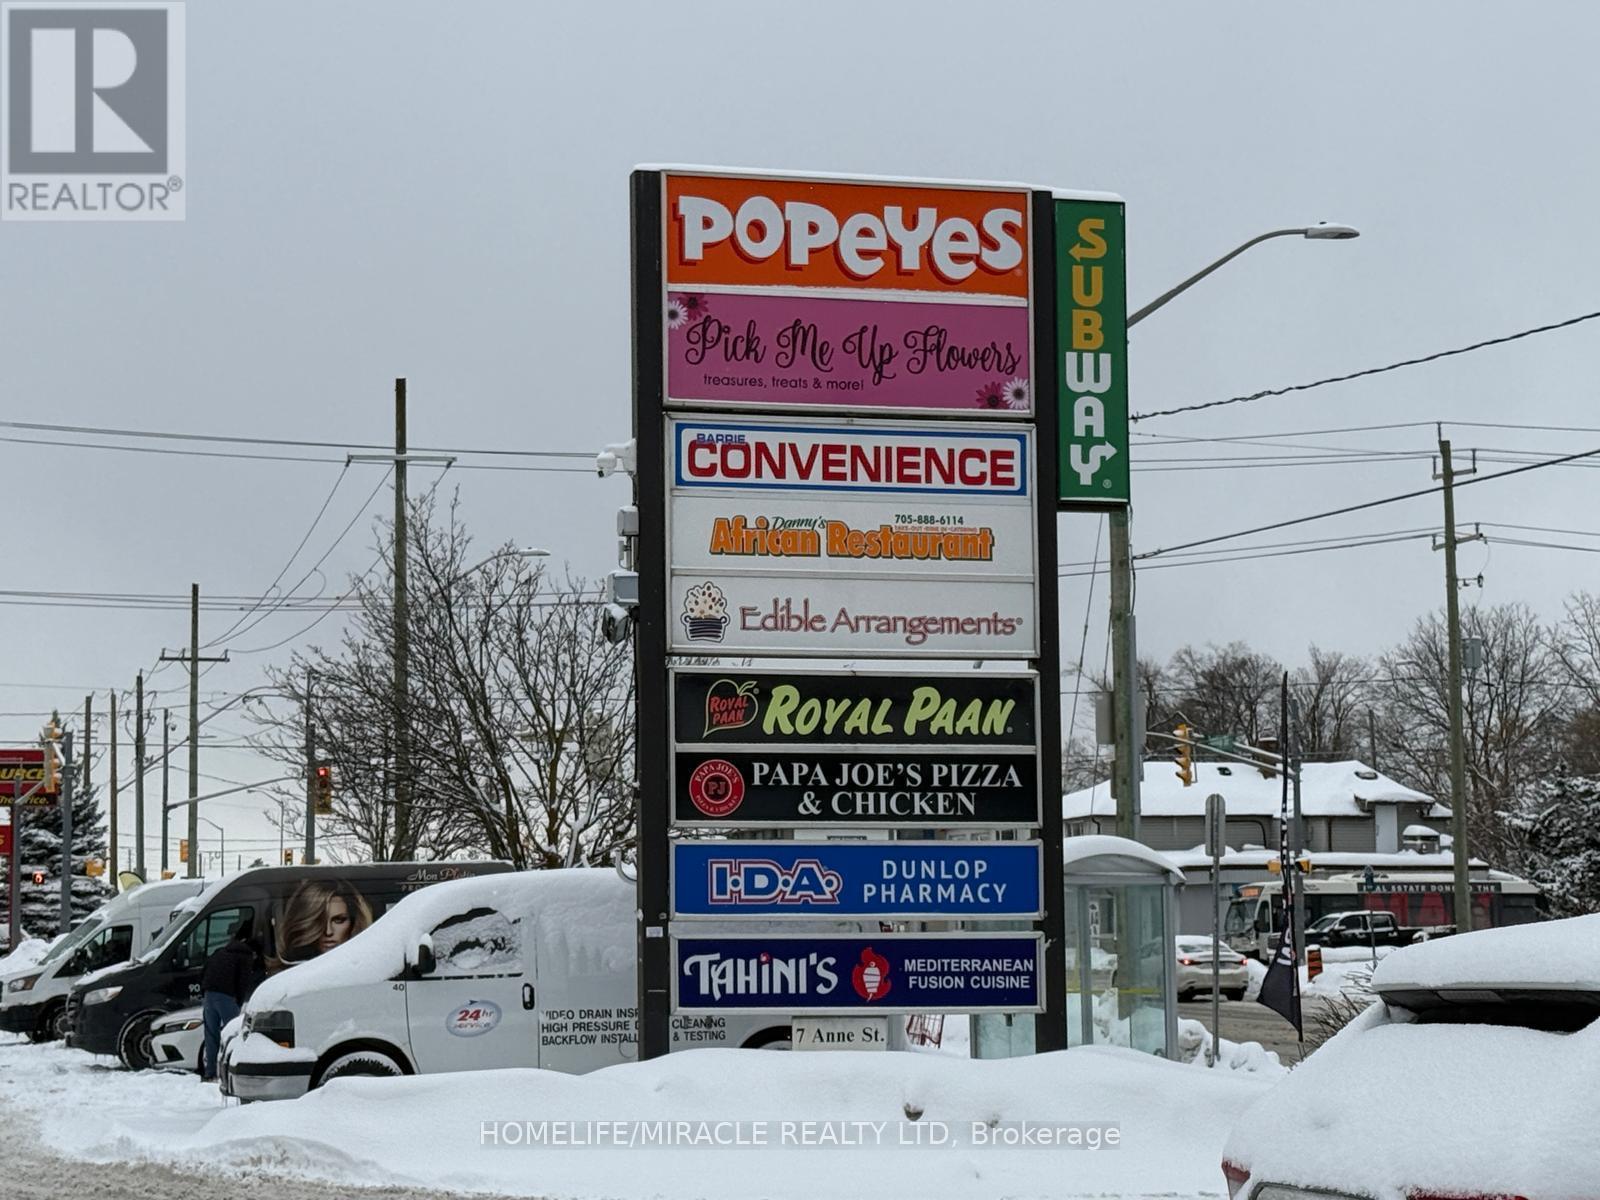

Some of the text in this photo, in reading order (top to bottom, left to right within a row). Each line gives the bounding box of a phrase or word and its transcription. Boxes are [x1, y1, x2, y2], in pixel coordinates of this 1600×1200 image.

[685, 315, 1021, 386] Pick Me Up Flowers
[1067, 218, 1118, 486] SUBWAY
[703, 374, 767, 389] treasures,
[772, 376, 808, 389] treats
[812, 377, 822, 390] &
[696, 433, 746, 444] BARRIE
[688, 439, 1016, 487] CONVENIENCE
[771, 515, 828, 531] Danny's
[894, 514, 964, 525] 705-888-6114
[710, 515, 995, 562] African Restaurant
[739, 597, 827, 633] Edible
[710, 696, 748, 712] ROYAL
[762, 684, 1016, 736] ROYAL PAAN
[713, 709, 745, 725] PAAN
[751, 762, 1023, 788] PAPA JOE'S PIZZA
[798, 791, 977, 816] & CHICKEN
[882, 860, 988, 879] DUNLOP
[863, 884, 1008, 904] PHARMACY
[904, 958, 1034, 973] MEDITERRANEAN
[392, 983, 405, 992] 40
[908, 975, 1031, 990] FUSION CUISINE
[579, 1009, 612, 1020] DRAIN
[541, 1023, 568, 1033] HIGH
[572, 1021, 630, 1032] PRESSURE
[795, 1026, 885, 1044] 7 Anne St.
[541, 1036, 596, 1046] BACKFLOW
[672, 1032, 680, 1042] &
[684, 1030, 726, 1041] TESTING
